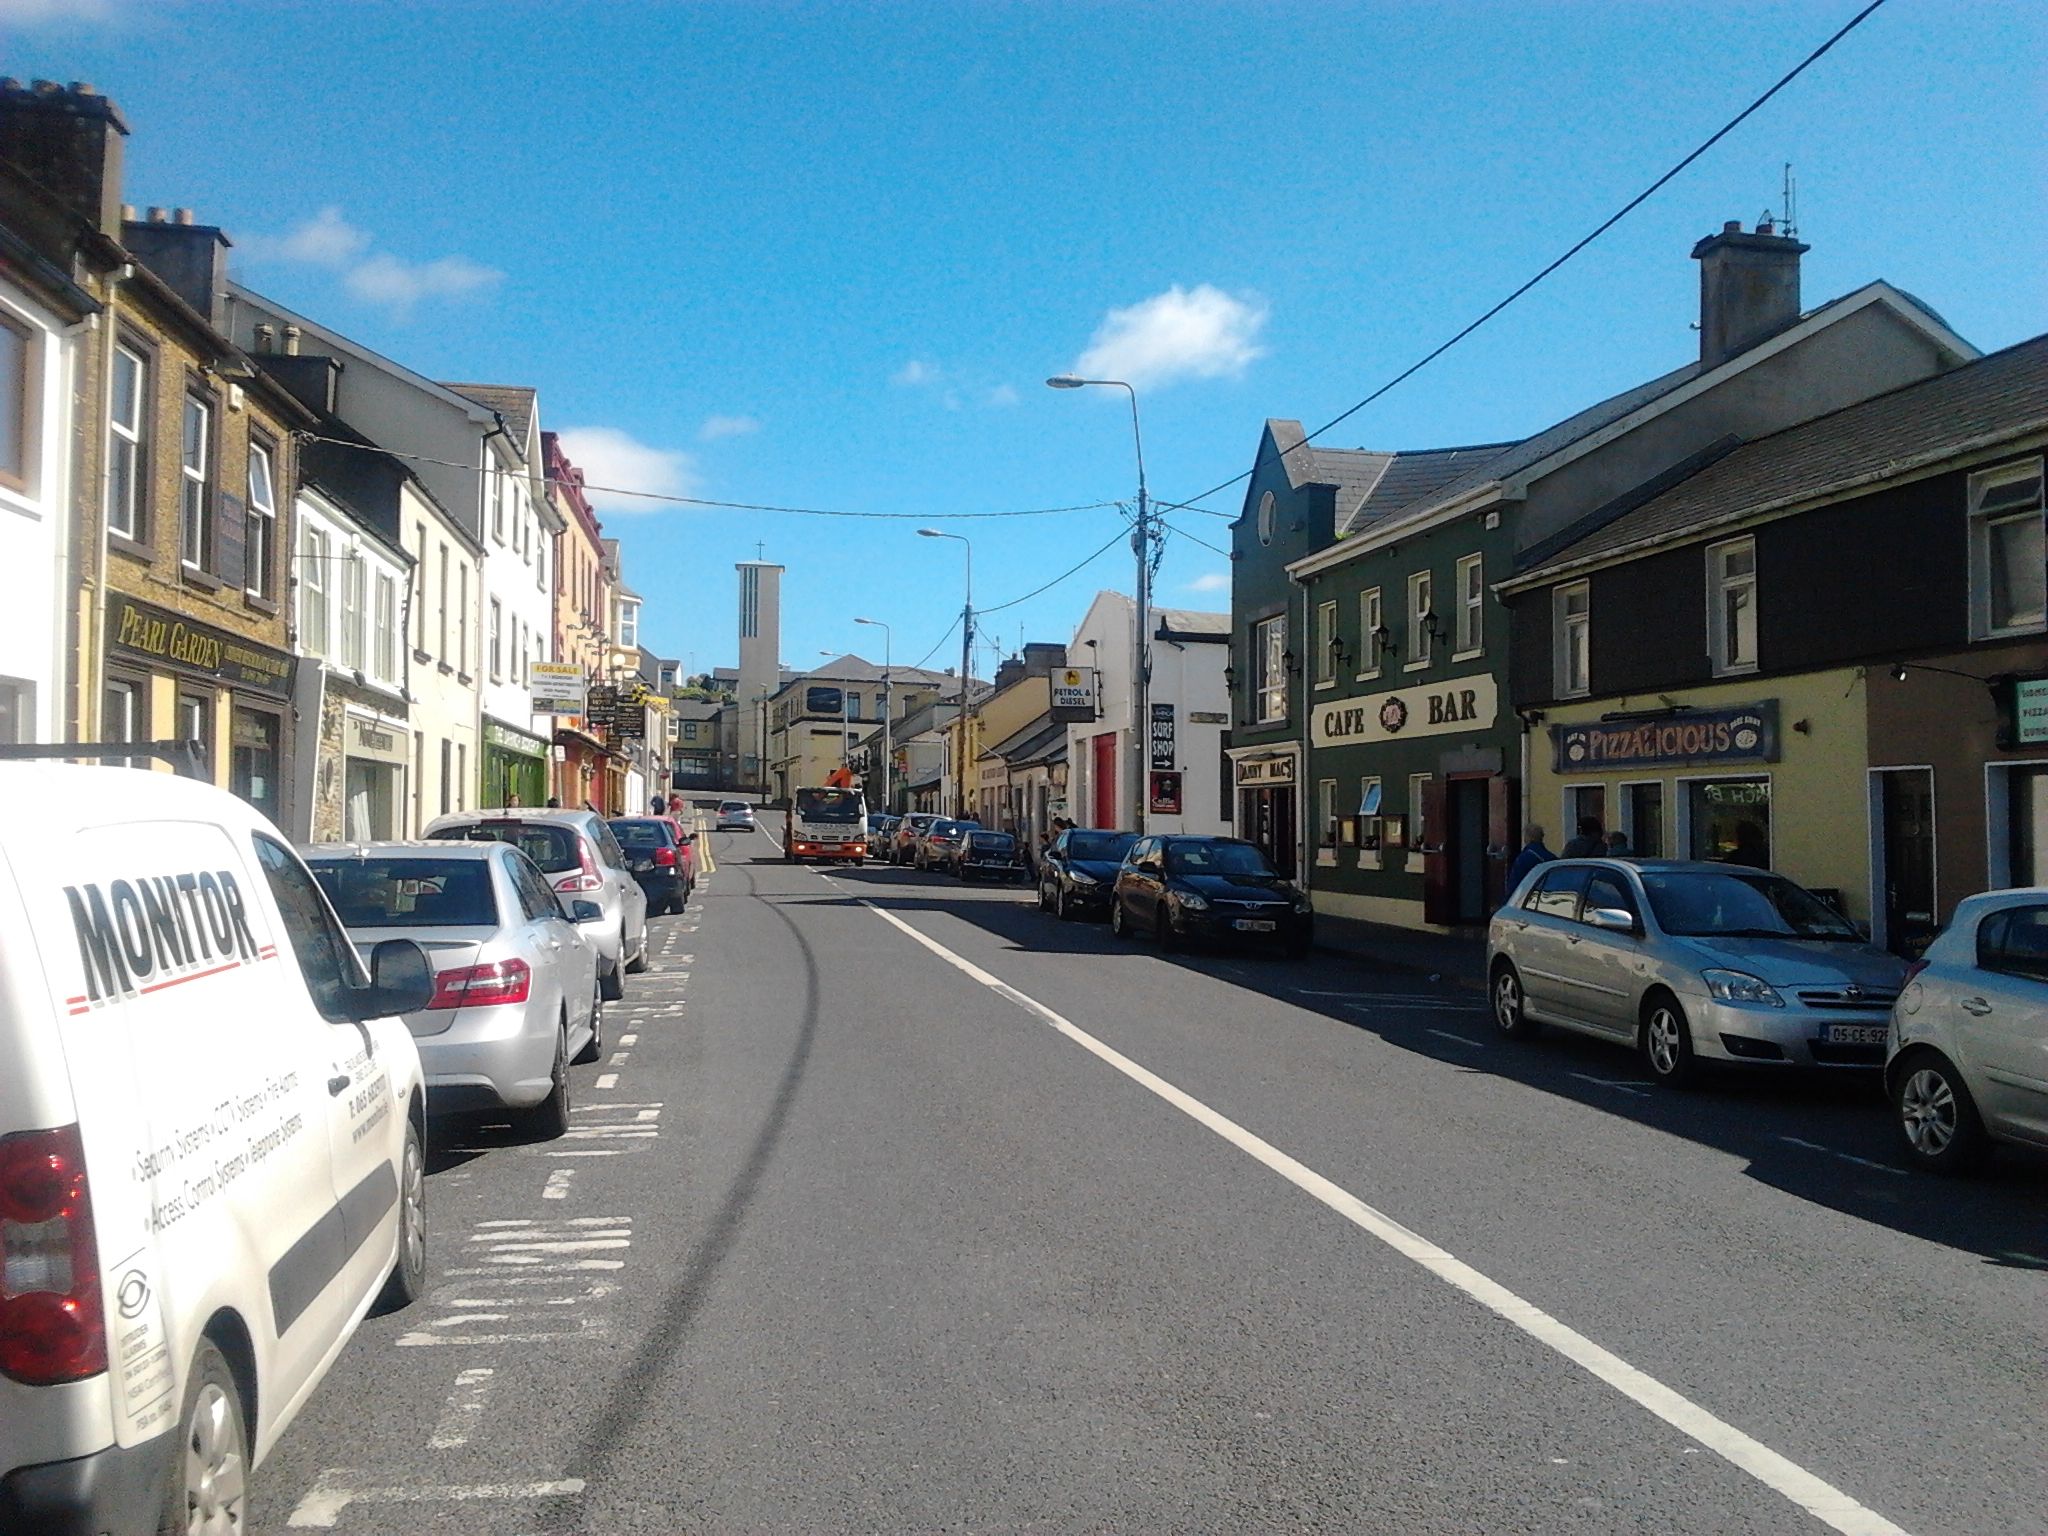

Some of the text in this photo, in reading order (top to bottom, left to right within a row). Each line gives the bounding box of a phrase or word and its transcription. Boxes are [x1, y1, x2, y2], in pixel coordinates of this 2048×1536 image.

[117, 604, 167, 654] PEARL
[169, 622, 223, 669] GARDEN
[536, 664, 578, 675] FOR SALE
[1054, 688, 1091, 697] PETROL &
[1060, 697, 1086, 706] DIESEL
[1324, 707, 1365, 738] CAFE
[1427, 689, 1478, 725] BAR
[1152, 720, 1173, 739] SURF
[1152, 740, 1175, 757] SHOP
[1588, 721, 1731, 761] PIZZALICIOUS
[1238, 763, 1263, 782] DANNY
[62, 870, 261, 1005] MONITOR
[151, 1195, 187, 1236] Access
[183, 1170, 217, 1211] Control
[214, 1154, 246, 1195] Systems
